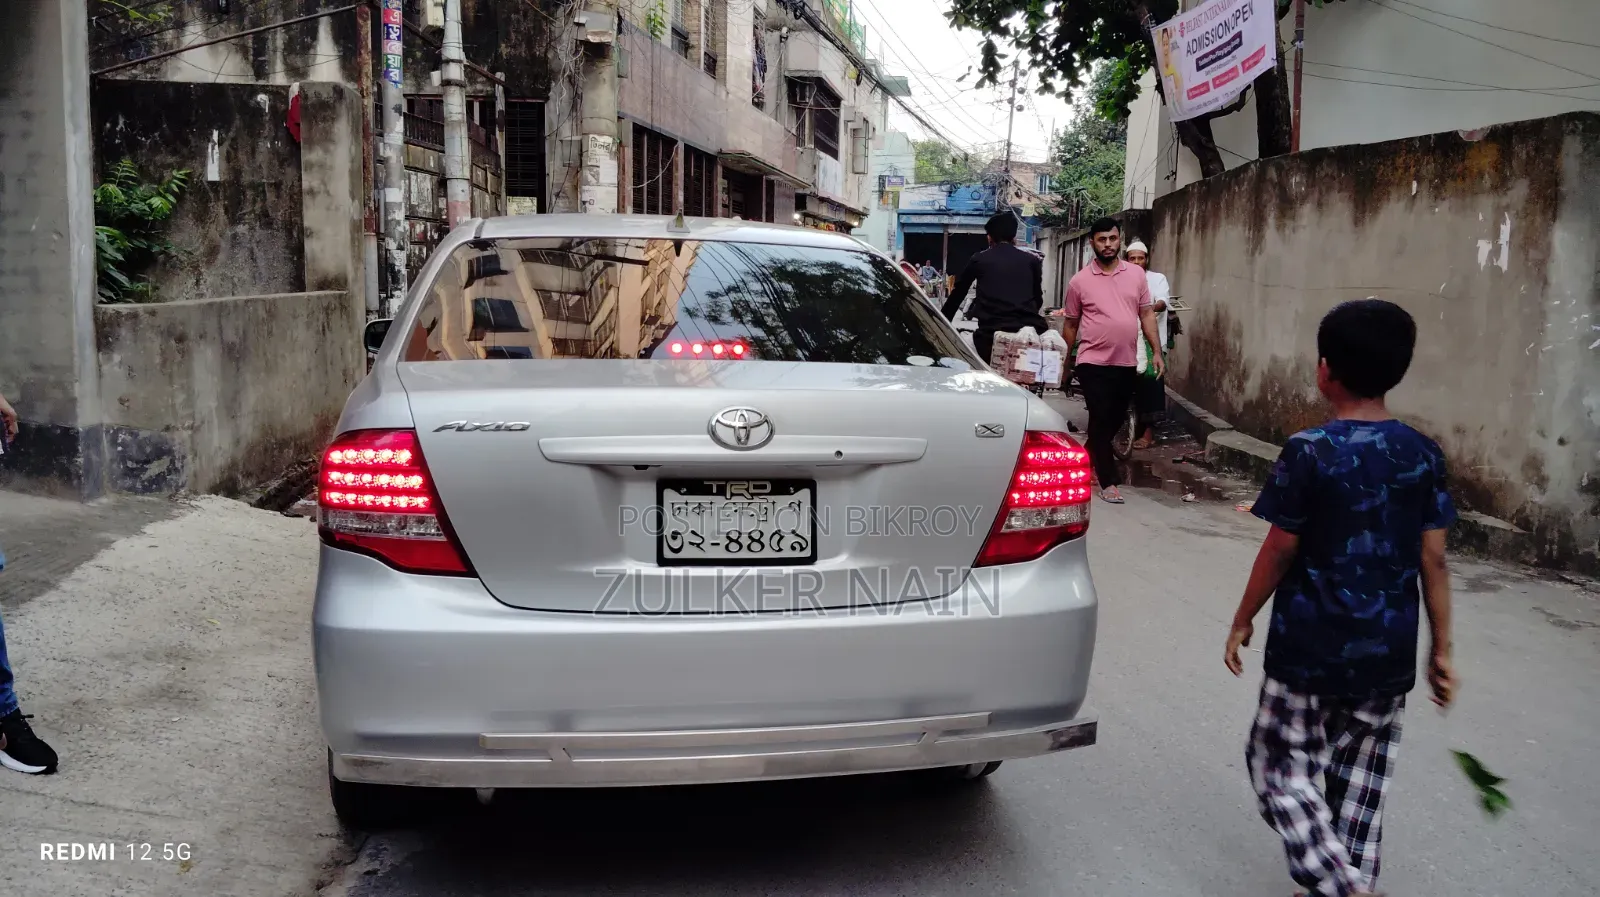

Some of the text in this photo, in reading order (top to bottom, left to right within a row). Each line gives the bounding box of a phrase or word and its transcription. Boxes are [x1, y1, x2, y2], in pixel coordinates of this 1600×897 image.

[1186, 18, 1231, 57] ADMISSION
[1231, 0, 1254, 30] OPEN
[703, 480, 772, 500] TRD
[668, 499, 715, 517] ঢাকা
[722, 496, 776, 522] মেট্রো
[664, 528, 809, 555] ৩২-৪৪৫৯
